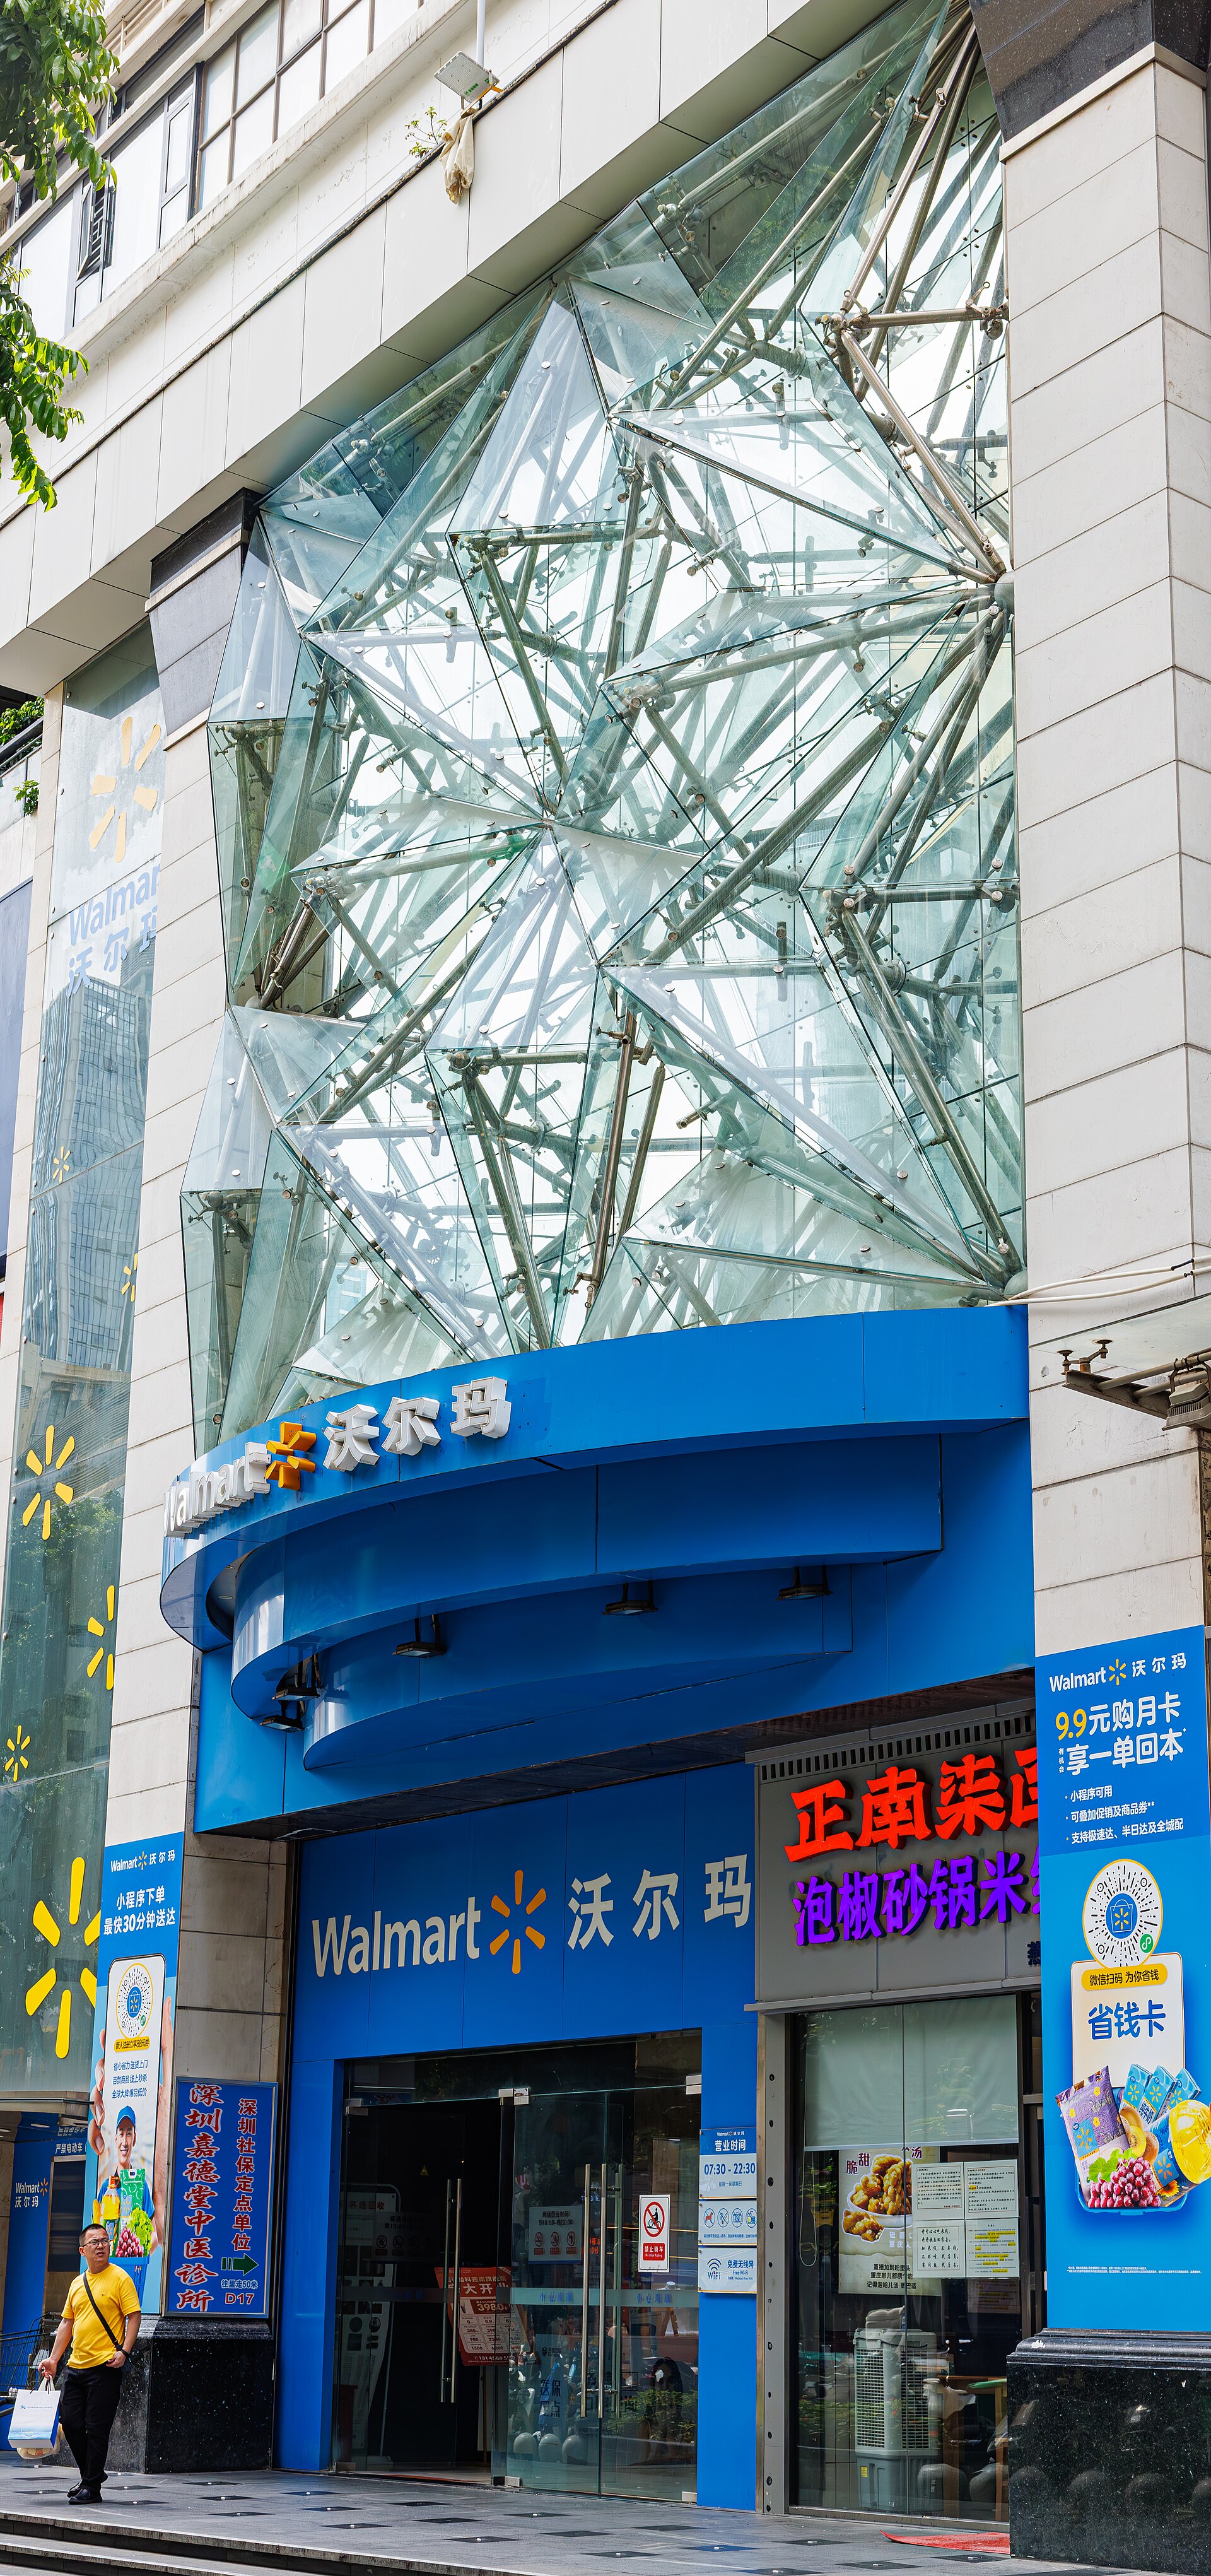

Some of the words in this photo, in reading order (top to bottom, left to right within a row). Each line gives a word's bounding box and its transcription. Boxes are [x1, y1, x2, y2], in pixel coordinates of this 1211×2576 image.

[323, 1376, 512, 1471] 沃尔玛
[1050, 1666, 1106, 1692] Walmart
[1132, 1652, 1186, 1678] 沃尔玛
[1055, 1691, 1181, 1741] 9.9元购月卡
[1070, 1785, 1113, 1803] 小程序可用
[110, 1856, 137, 1873] Walmart
[149, 1849, 175, 1866] 沃尔玛
[116, 1885, 165, 1910] 小程序下单
[792, 1845, 1039, 1946] 泡椒砂锅米
[103, 1907, 176, 1936] 最快30分钟送达
[312, 1897, 481, 1978] Walmart
[567, 1853, 751, 1951] 沃尔玛
[1089, 1973, 1123, 1986] 微信扫码
[1125, 1969, 1159, 1984] 为你省钱
[1088, 1999, 1166, 2040] 省钱卡
[114, 2061, 130, 2071] 省心省力
[131, 2059, 148, 2069] 送货上门
[113, 2075, 129, 2085] 百款商品
[112, 2090, 129, 2099] 全球大牌
[56, 2143, 83, 2154] 严禁电动车
[715, 2139, 746, 2151] 营业时间
[231, 2098, 257, 2252] 深圳社保定点单位
[705, 2163, 725, 2175] 07:30
[734, 2162, 756, 2175] 22:30
[16, 2182, 39, 2194] Walmart
[15, 2196, 38, 2208] 沃尔玛
[175, 2083, 224, 2312] 深圳嘉德堂中医诊所
[727, 2260, 754, 2269] 免费无线网
[708, 2271, 721, 2279] WiFi
[221, 2279, 258, 2290] 往里走50米
[225, 2293, 255, 2305] D17
